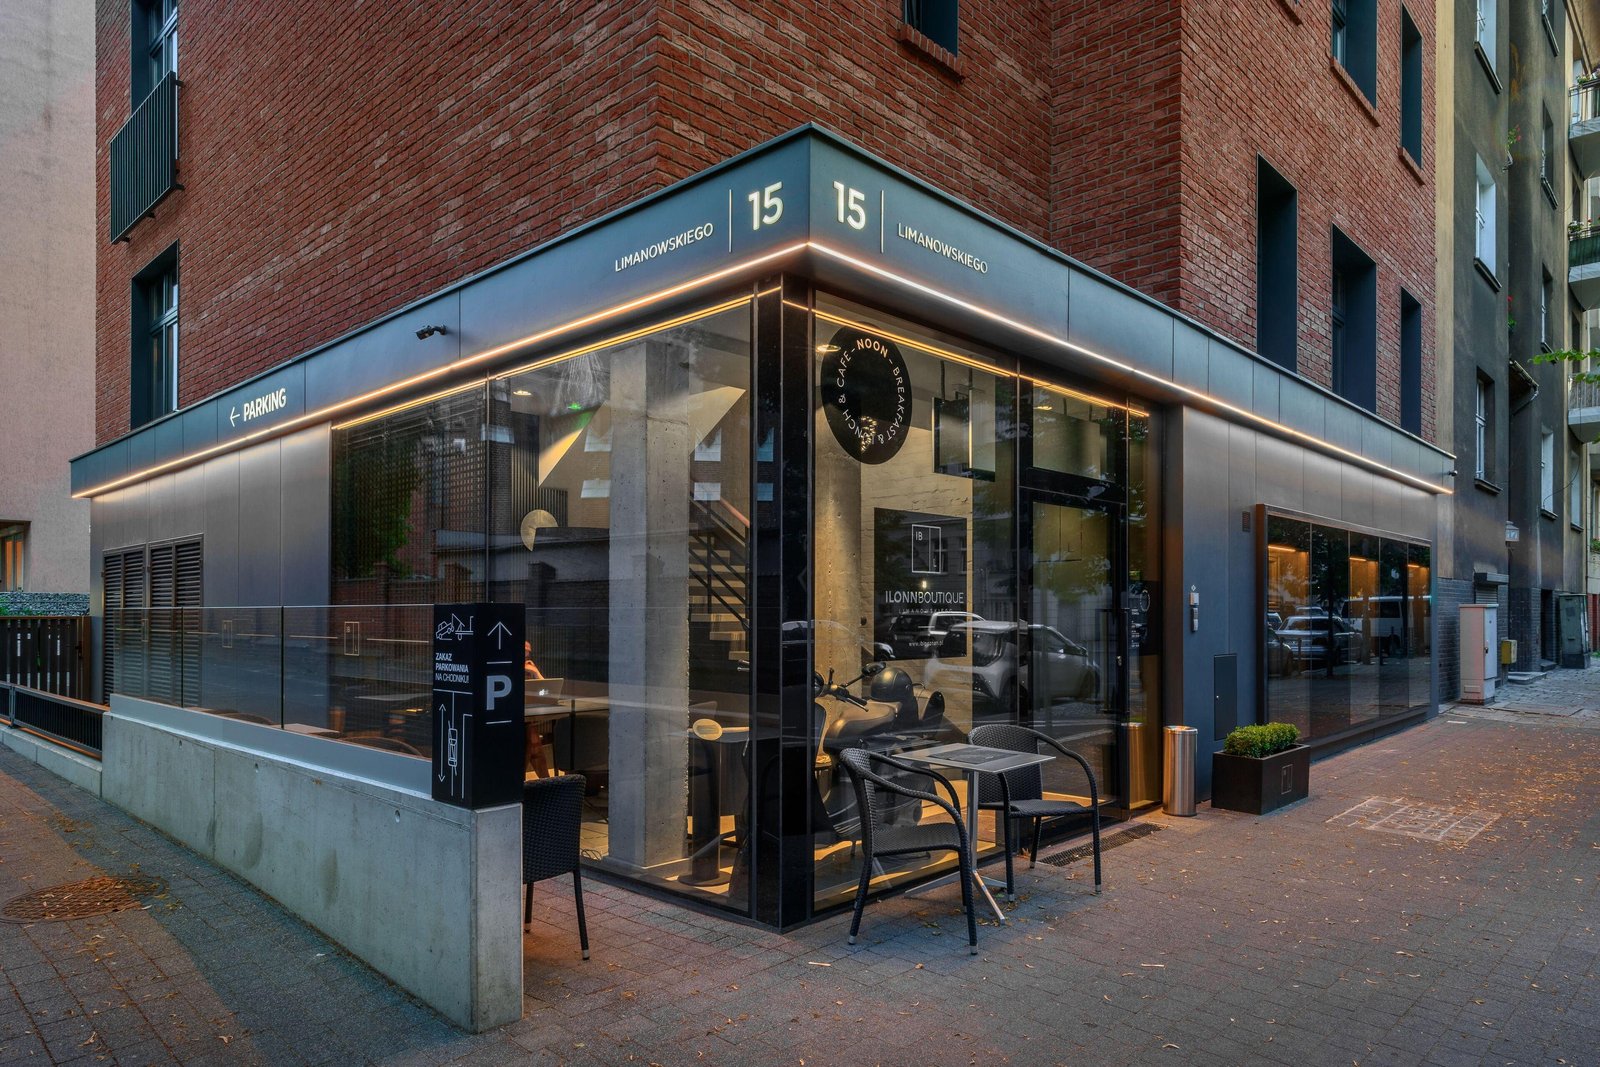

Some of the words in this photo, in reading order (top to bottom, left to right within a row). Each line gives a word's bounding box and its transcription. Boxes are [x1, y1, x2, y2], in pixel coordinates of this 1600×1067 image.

[748, 181, 784, 231] 15
[833, 180, 867, 230] 15
[614, 222, 714, 273] LIMANOWSKIEGO
[897, 222, 989, 275] LIMANOWSKIEGO
[856, 338, 888, 358] NOON
[837, 351, 852, 388] CAFE
[243, 387, 287, 422] PARKING
[886, 366, 905, 441] BREAKFAST
[885, 590, 965, 604] ILONNBOUTIQUE
[435, 652, 452, 661] ZAKAZ
[435, 662, 469, 673] PARKOWANIA
[435, 673, 442, 681] NA
[486, 674, 512, 711] P
